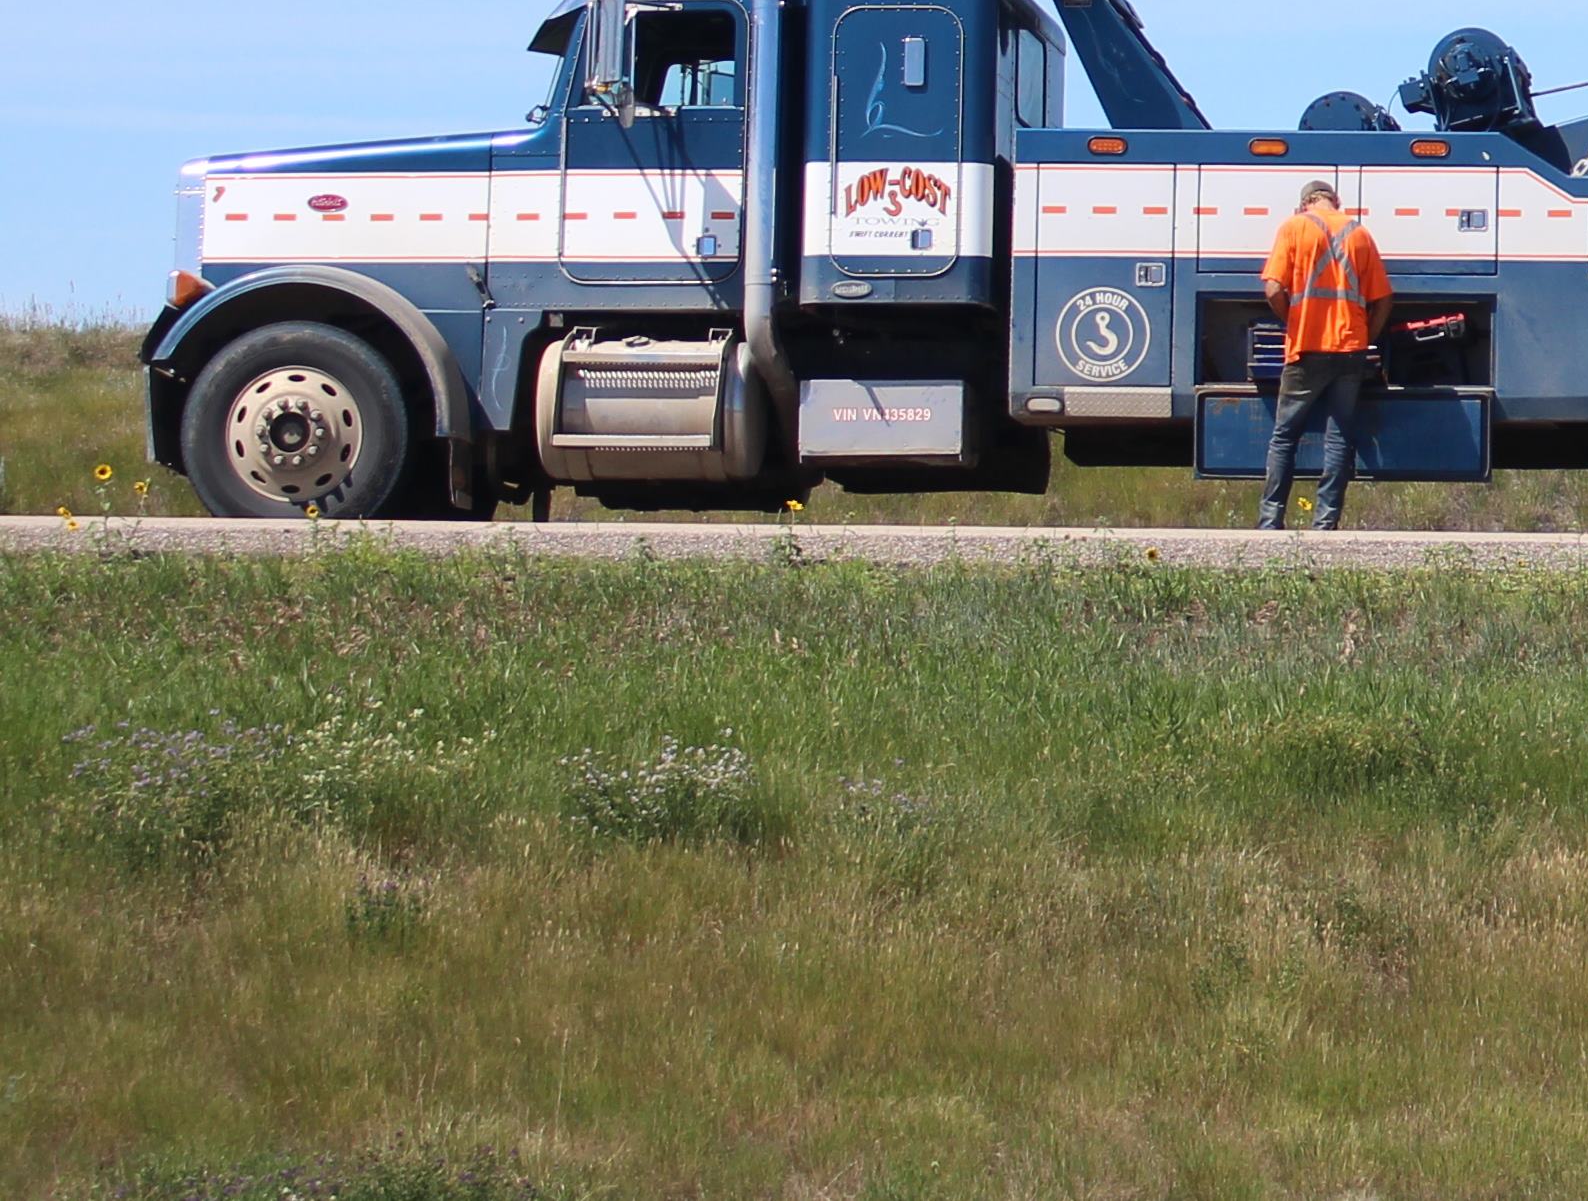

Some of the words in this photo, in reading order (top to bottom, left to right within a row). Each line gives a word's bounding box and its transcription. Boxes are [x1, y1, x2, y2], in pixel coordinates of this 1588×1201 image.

[844, 165, 952, 217] LOW-COST
[851, 216, 940, 228] TOWING
[1076, 295, 1093, 311] 24
[1095, 292, 1129, 311] HOUR
[1075, 359, 1129, 378] SERVICE
[832, 407, 857, 421] VIN
